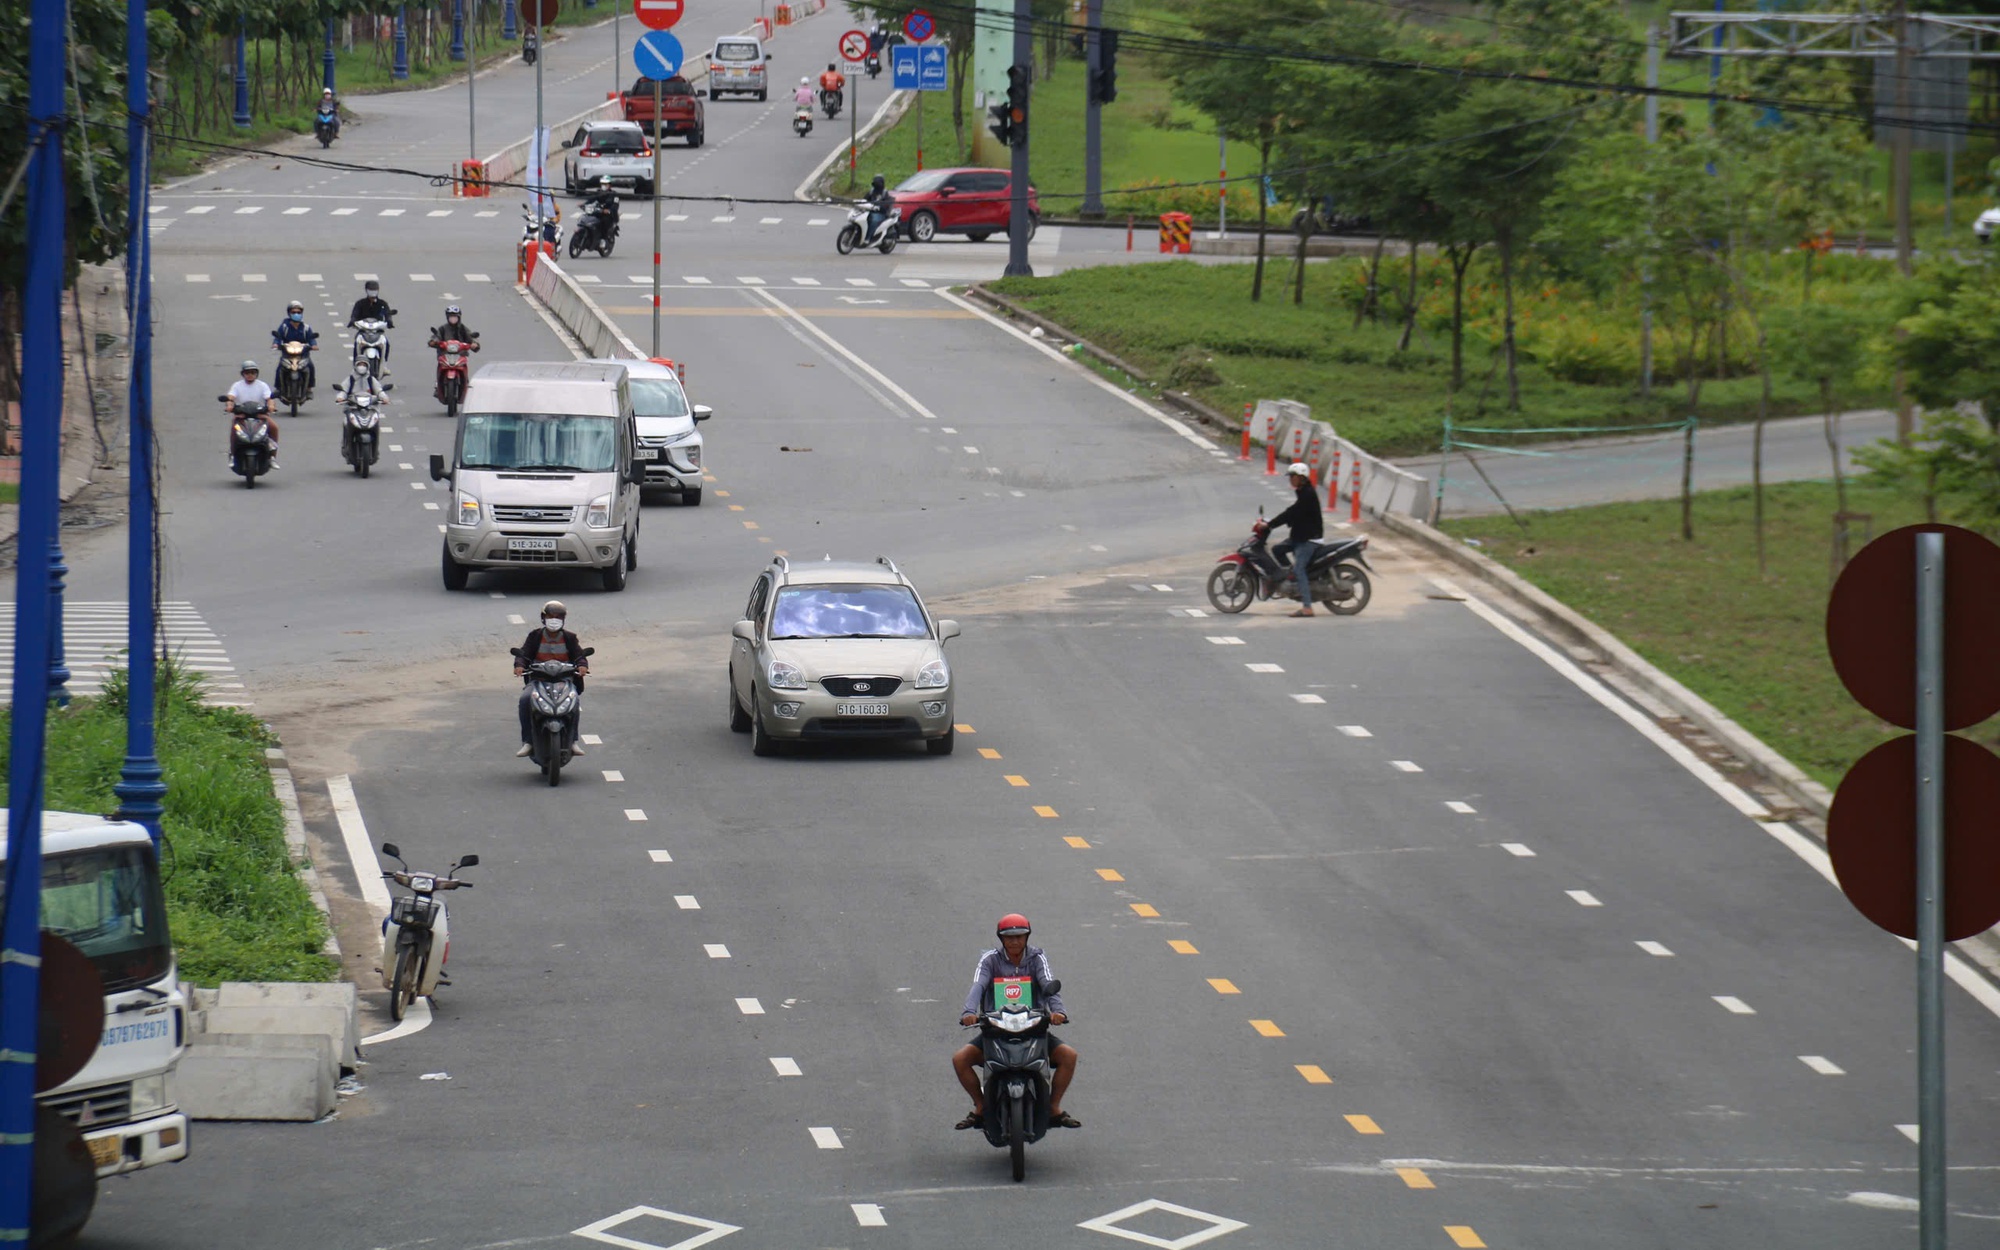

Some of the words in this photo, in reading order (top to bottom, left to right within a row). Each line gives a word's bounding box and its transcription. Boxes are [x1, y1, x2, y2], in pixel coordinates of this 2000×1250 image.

[512, 540, 553, 549] 51E-324.40
[838, 704, 888, 715] 51G-160.33
[1006, 988, 1020, 996] RP7
